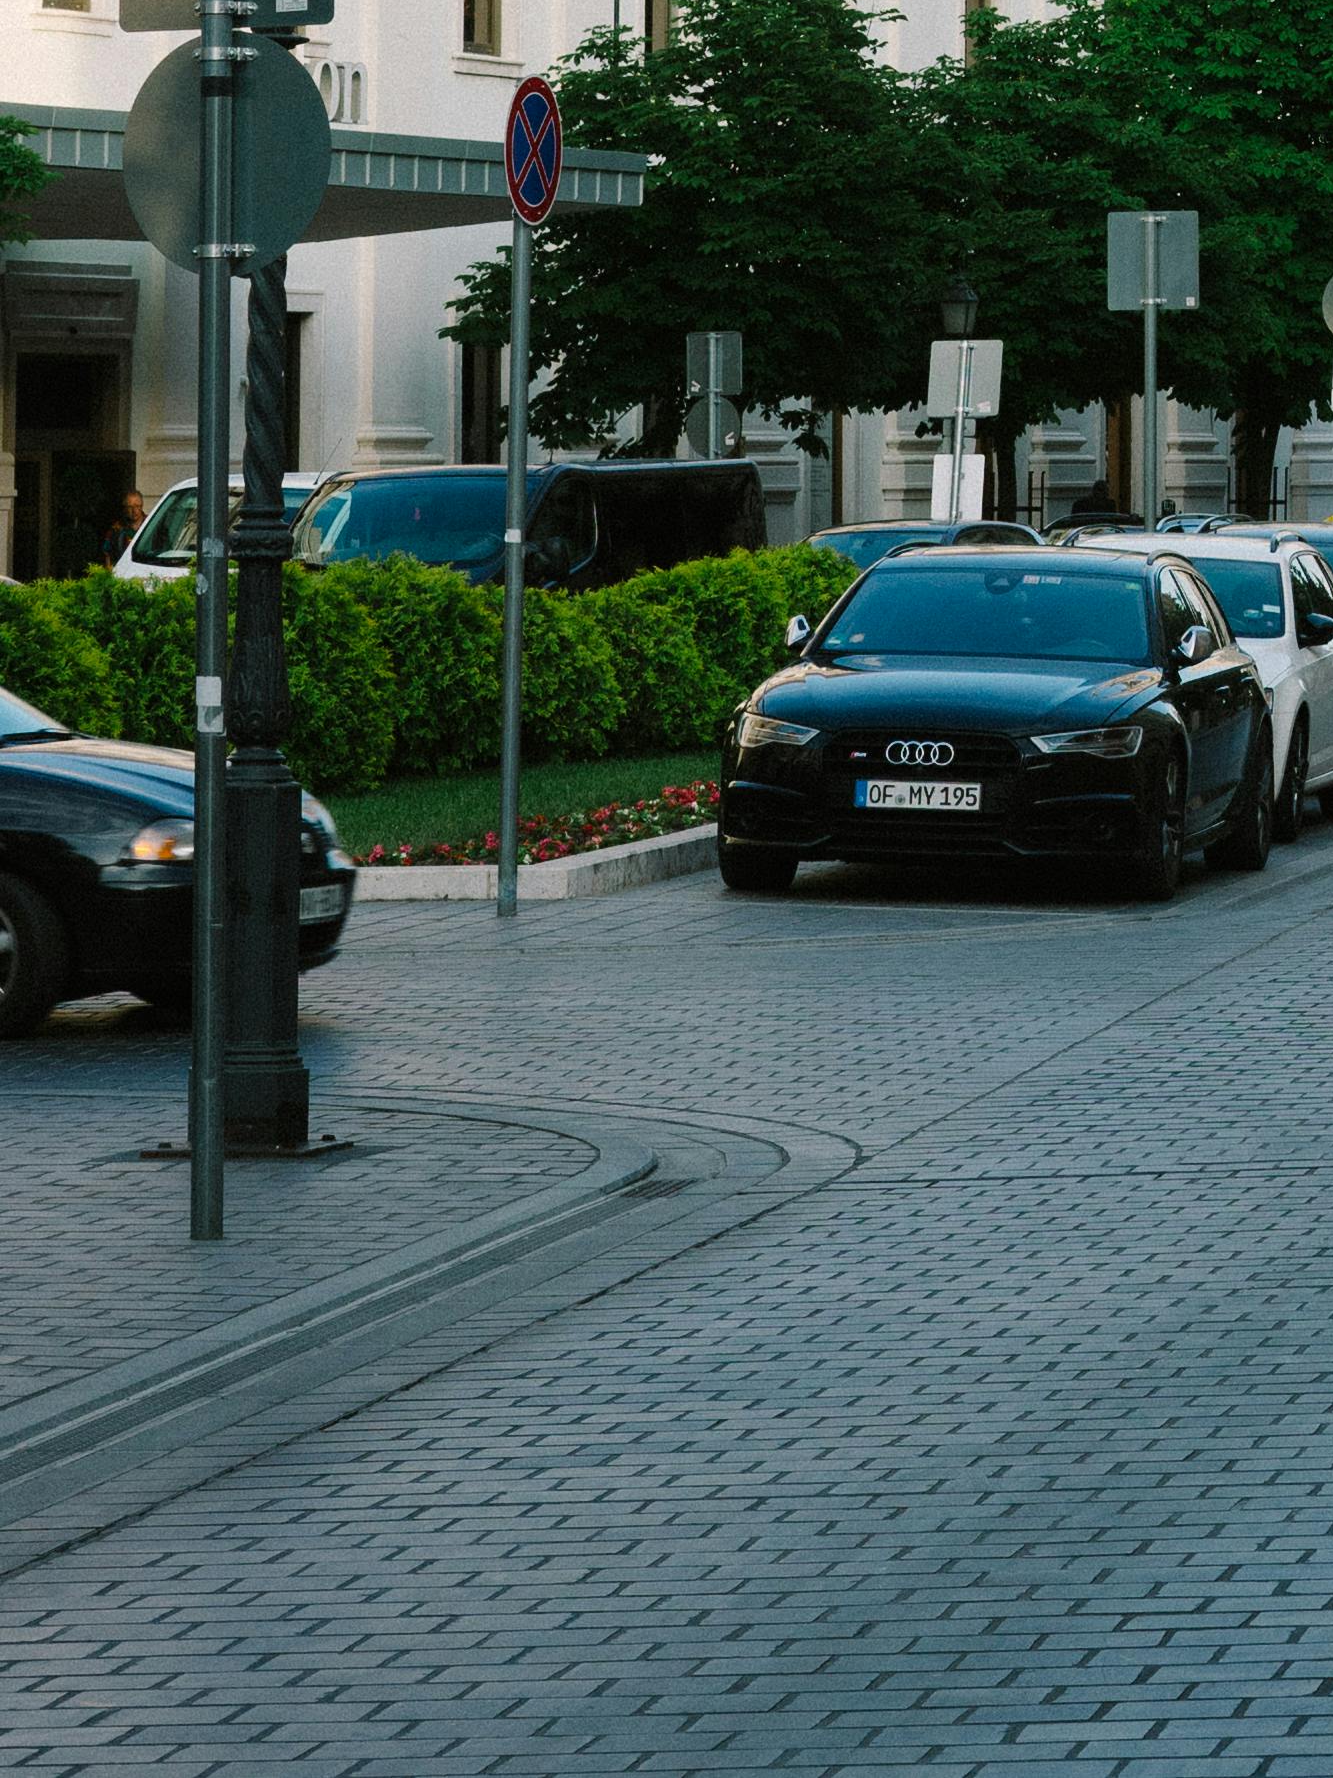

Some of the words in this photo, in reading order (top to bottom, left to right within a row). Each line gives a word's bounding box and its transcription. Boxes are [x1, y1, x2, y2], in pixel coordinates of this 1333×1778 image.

[869, 784, 895, 804] OF
[909, 785, 935, 805] MY
[939, 786, 978, 807] 195
